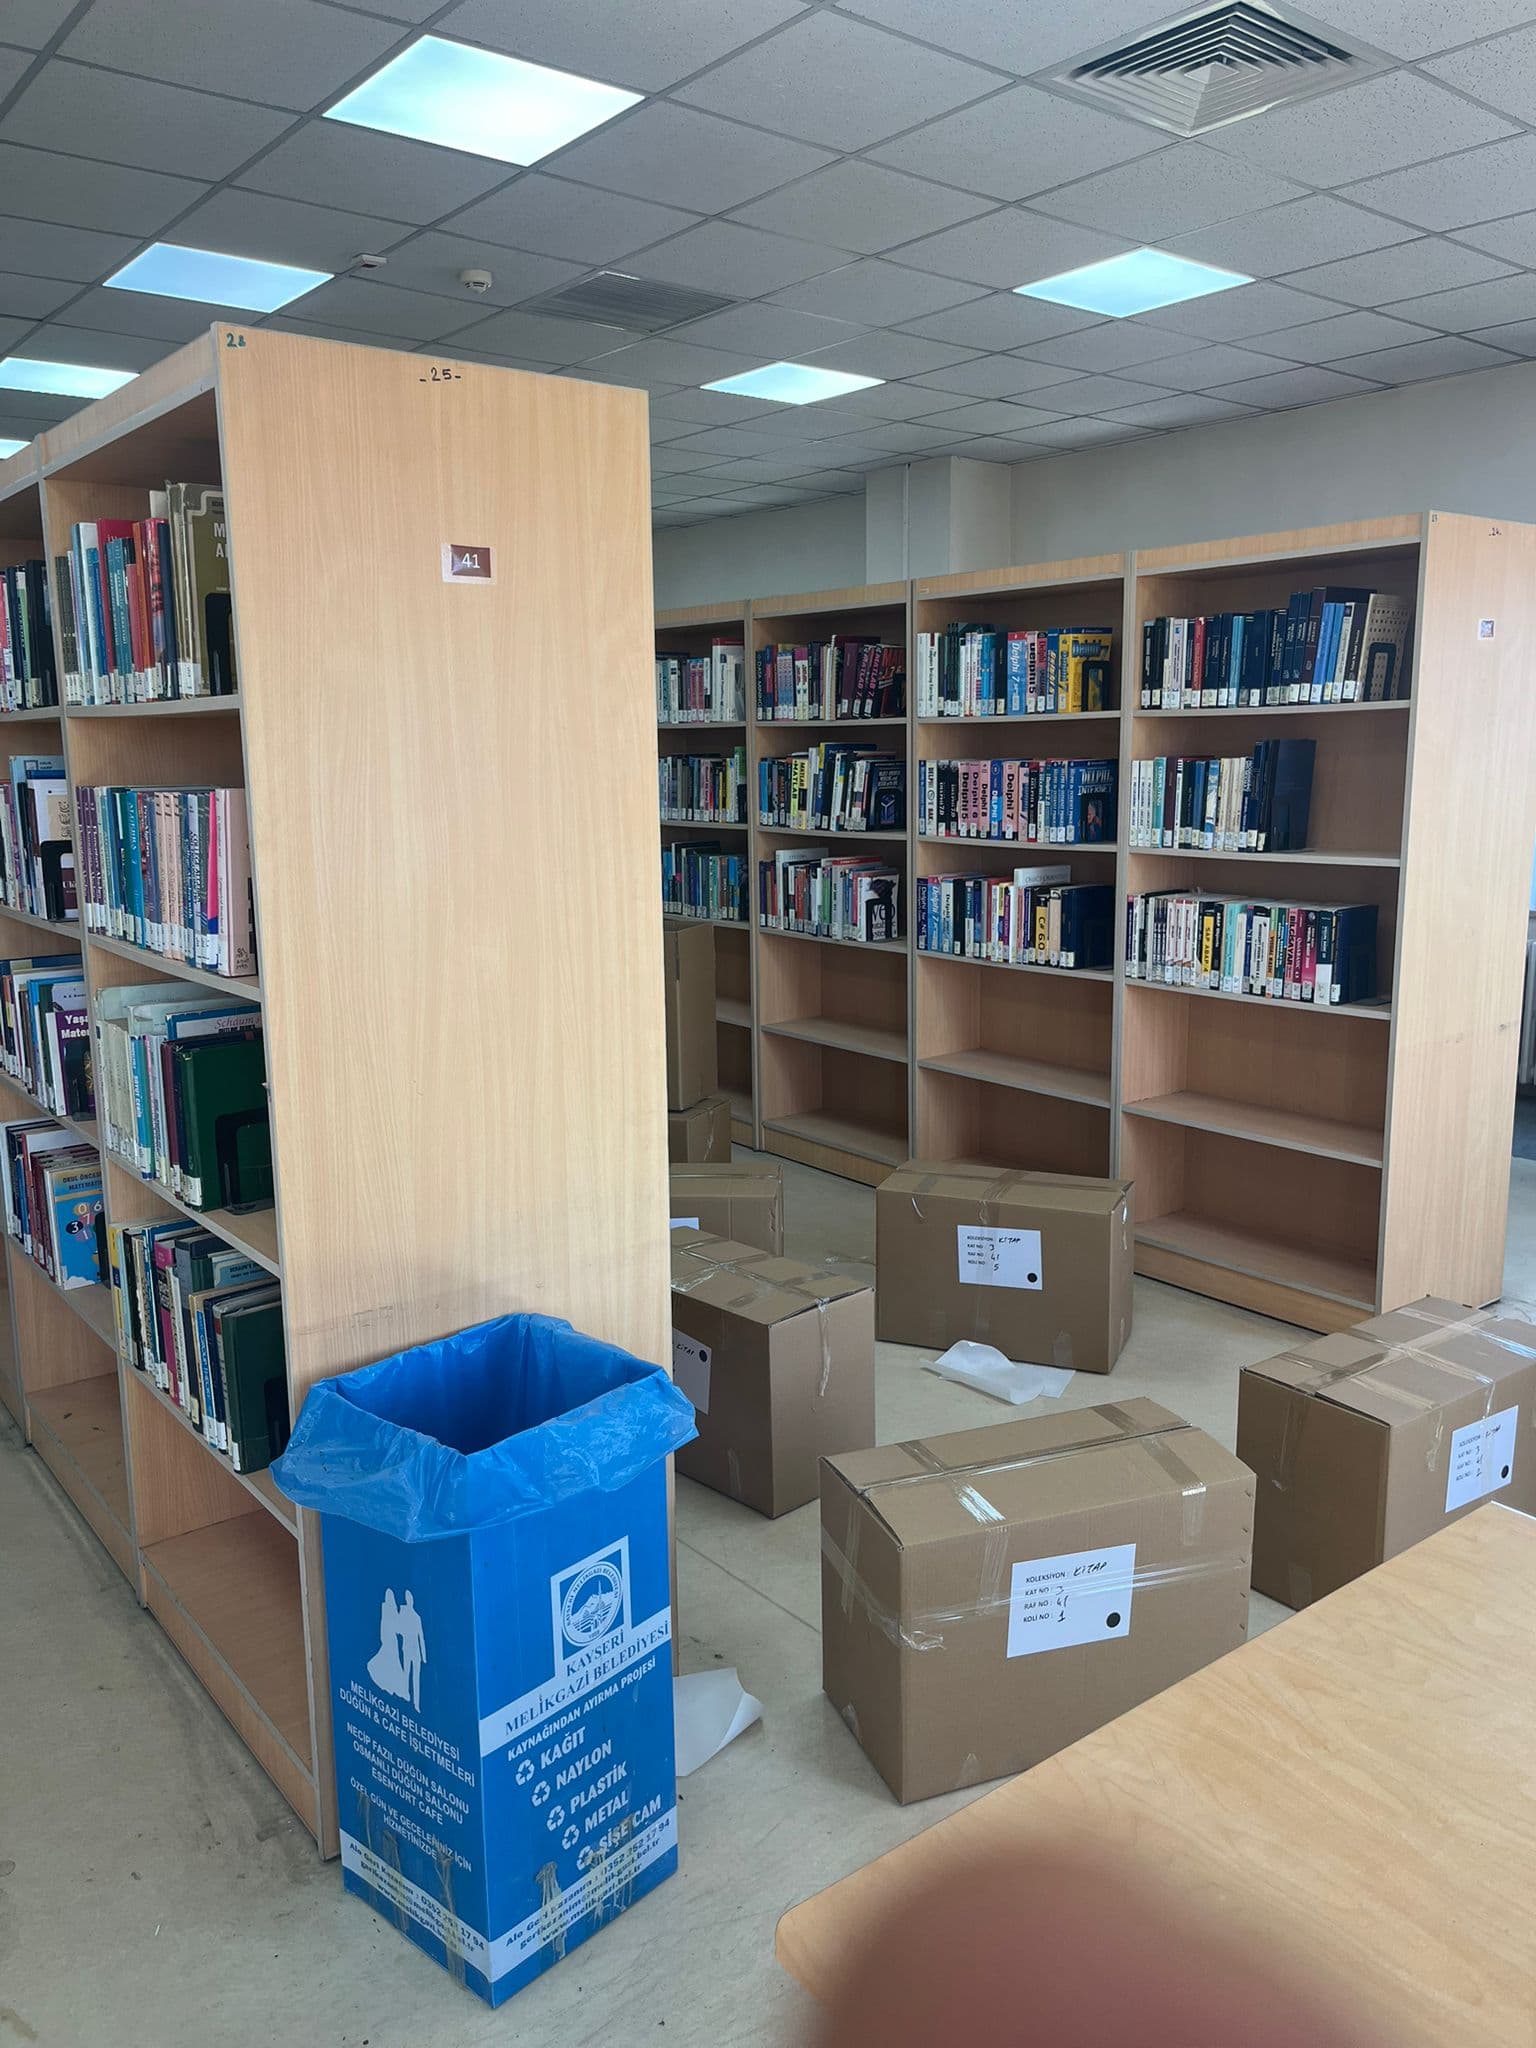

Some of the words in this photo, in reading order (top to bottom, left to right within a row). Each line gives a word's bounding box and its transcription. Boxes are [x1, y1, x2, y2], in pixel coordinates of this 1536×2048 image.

[461, 551, 480, 569] 41
[1007, 773, 1015, 811] Delphi
[71, 1221, 79, 1233] 3
[1057, 1610, 1066, 1623] 1
[566, 1629, 624, 1676] KAYSERİ
[505, 1669, 590, 1736] MELİKGAZİ
[593, 1620, 669, 1681] BELEDİYESİ
[351, 1680, 400, 1722] MELİKGAZİ
[401, 1715, 460, 1762] BELEDİYESİ
[507, 1707, 581, 1761] KAYNAĞINDAN
[583, 1682, 619, 1715] AYIRMA
[620, 1655, 656, 1688] PROJESİ
[340, 1688, 371, 1719] DÜĞÜN
[382, 1718, 407, 1743] CAFE
[409, 1733, 475, 1787] İŞLETMELERİ
[540, 1726, 586, 1769] KAĞIT
[347, 1722, 371, 1745] NECİP
[372, 1739, 396, 1765] FAZIL
[397, 1757, 429, 1787] DÜĞÜN
[430, 1780, 469, 1814] SALONU
[353, 1740, 390, 1774] OSMANLI
[391, 1767, 423, 1797] DÜĞÜN
[424, 1790, 463, 1825] SALONU
[556, 1739, 612, 1790] NAYLON
[570, 1760, 628, 1814] PLASTİK
[371, 1767, 416, 1807] ESENYURT
[418, 1800, 443, 1826] CAFE
[584, 1789, 630, 1833] METAL
[632, 1794, 662, 1828] CAM
[658, 1817, 671, 1832] 94
[454, 1849, 472, 1872] İÇİN
